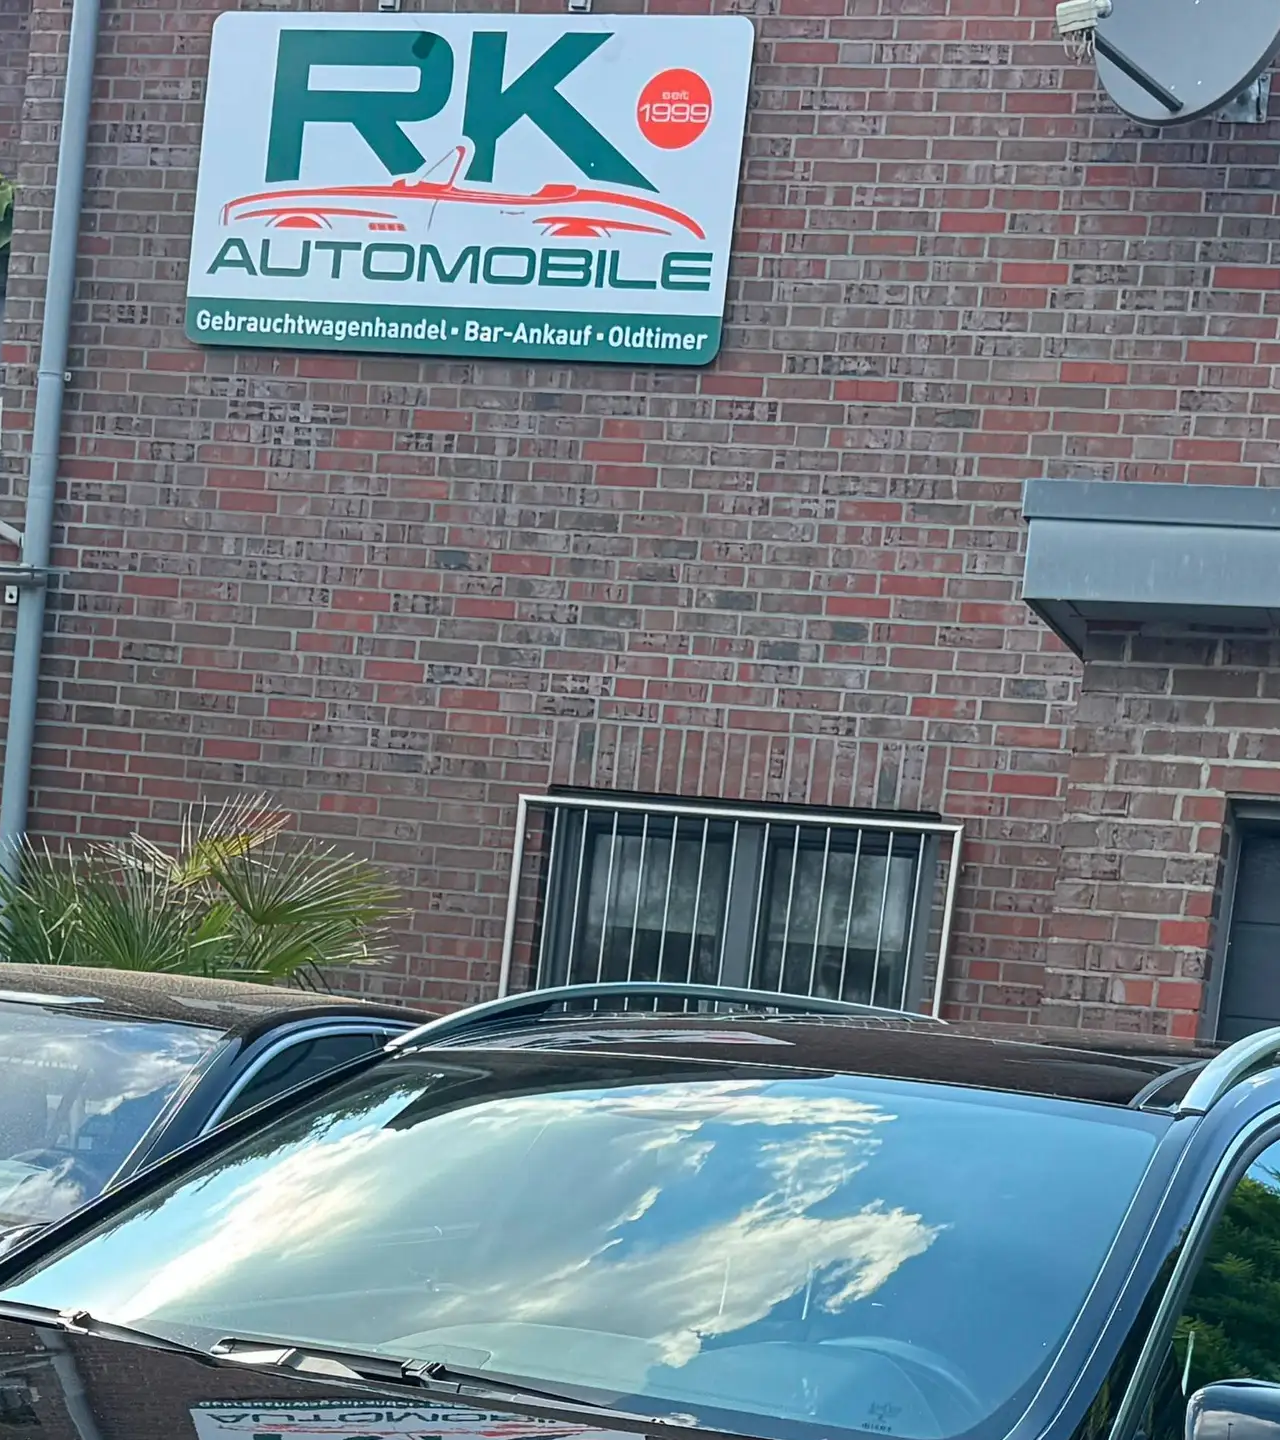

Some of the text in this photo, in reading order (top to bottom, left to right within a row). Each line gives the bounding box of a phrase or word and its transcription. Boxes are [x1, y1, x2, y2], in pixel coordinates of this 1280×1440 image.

[265, 29, 660, 193] RK
[639, 103, 709, 123] 1999
[206, 238, 713, 292] AUTOMOBILE
[196, 309, 708, 351] Gebrauchtwagenhandel Bar-Ankauf Oldtimer
